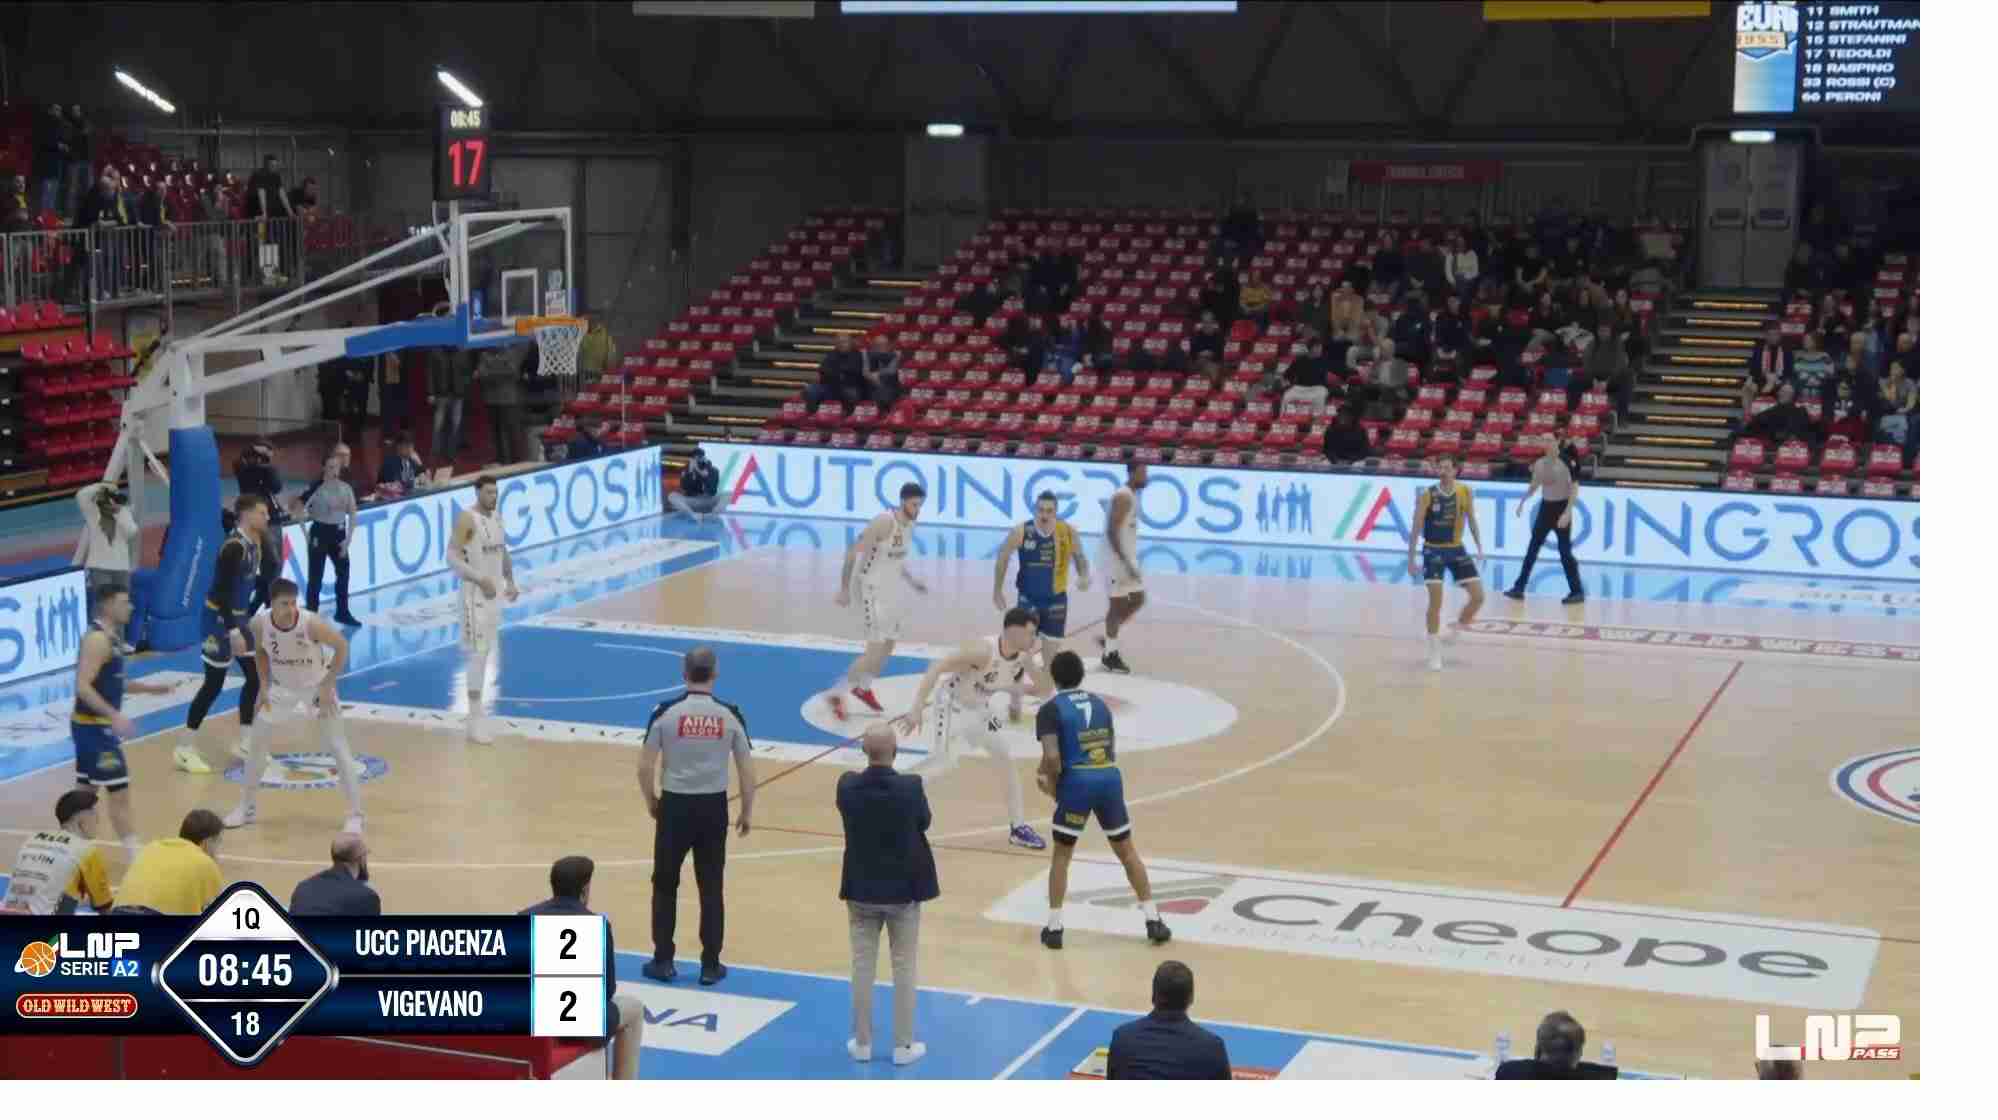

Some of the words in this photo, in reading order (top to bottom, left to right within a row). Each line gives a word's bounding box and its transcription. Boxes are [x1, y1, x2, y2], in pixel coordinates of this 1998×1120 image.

[1829, 5, 1880, 17] SMITH
[1828, 34, 1907, 45] STEFANINI
[1805, 49, 1823, 60] 17
[1829, 48, 1892, 60] TEDOLDI
[1826, 63, 1895, 74] RASPINO
[1826, 77, 1870, 88] ROSSI
[1825, 91, 1882, 102] PERONI
[448, 139, 485, 186] 17
[1075, 701, 1092, 729] 7
[1232, 894, 1830, 978] Cheope
